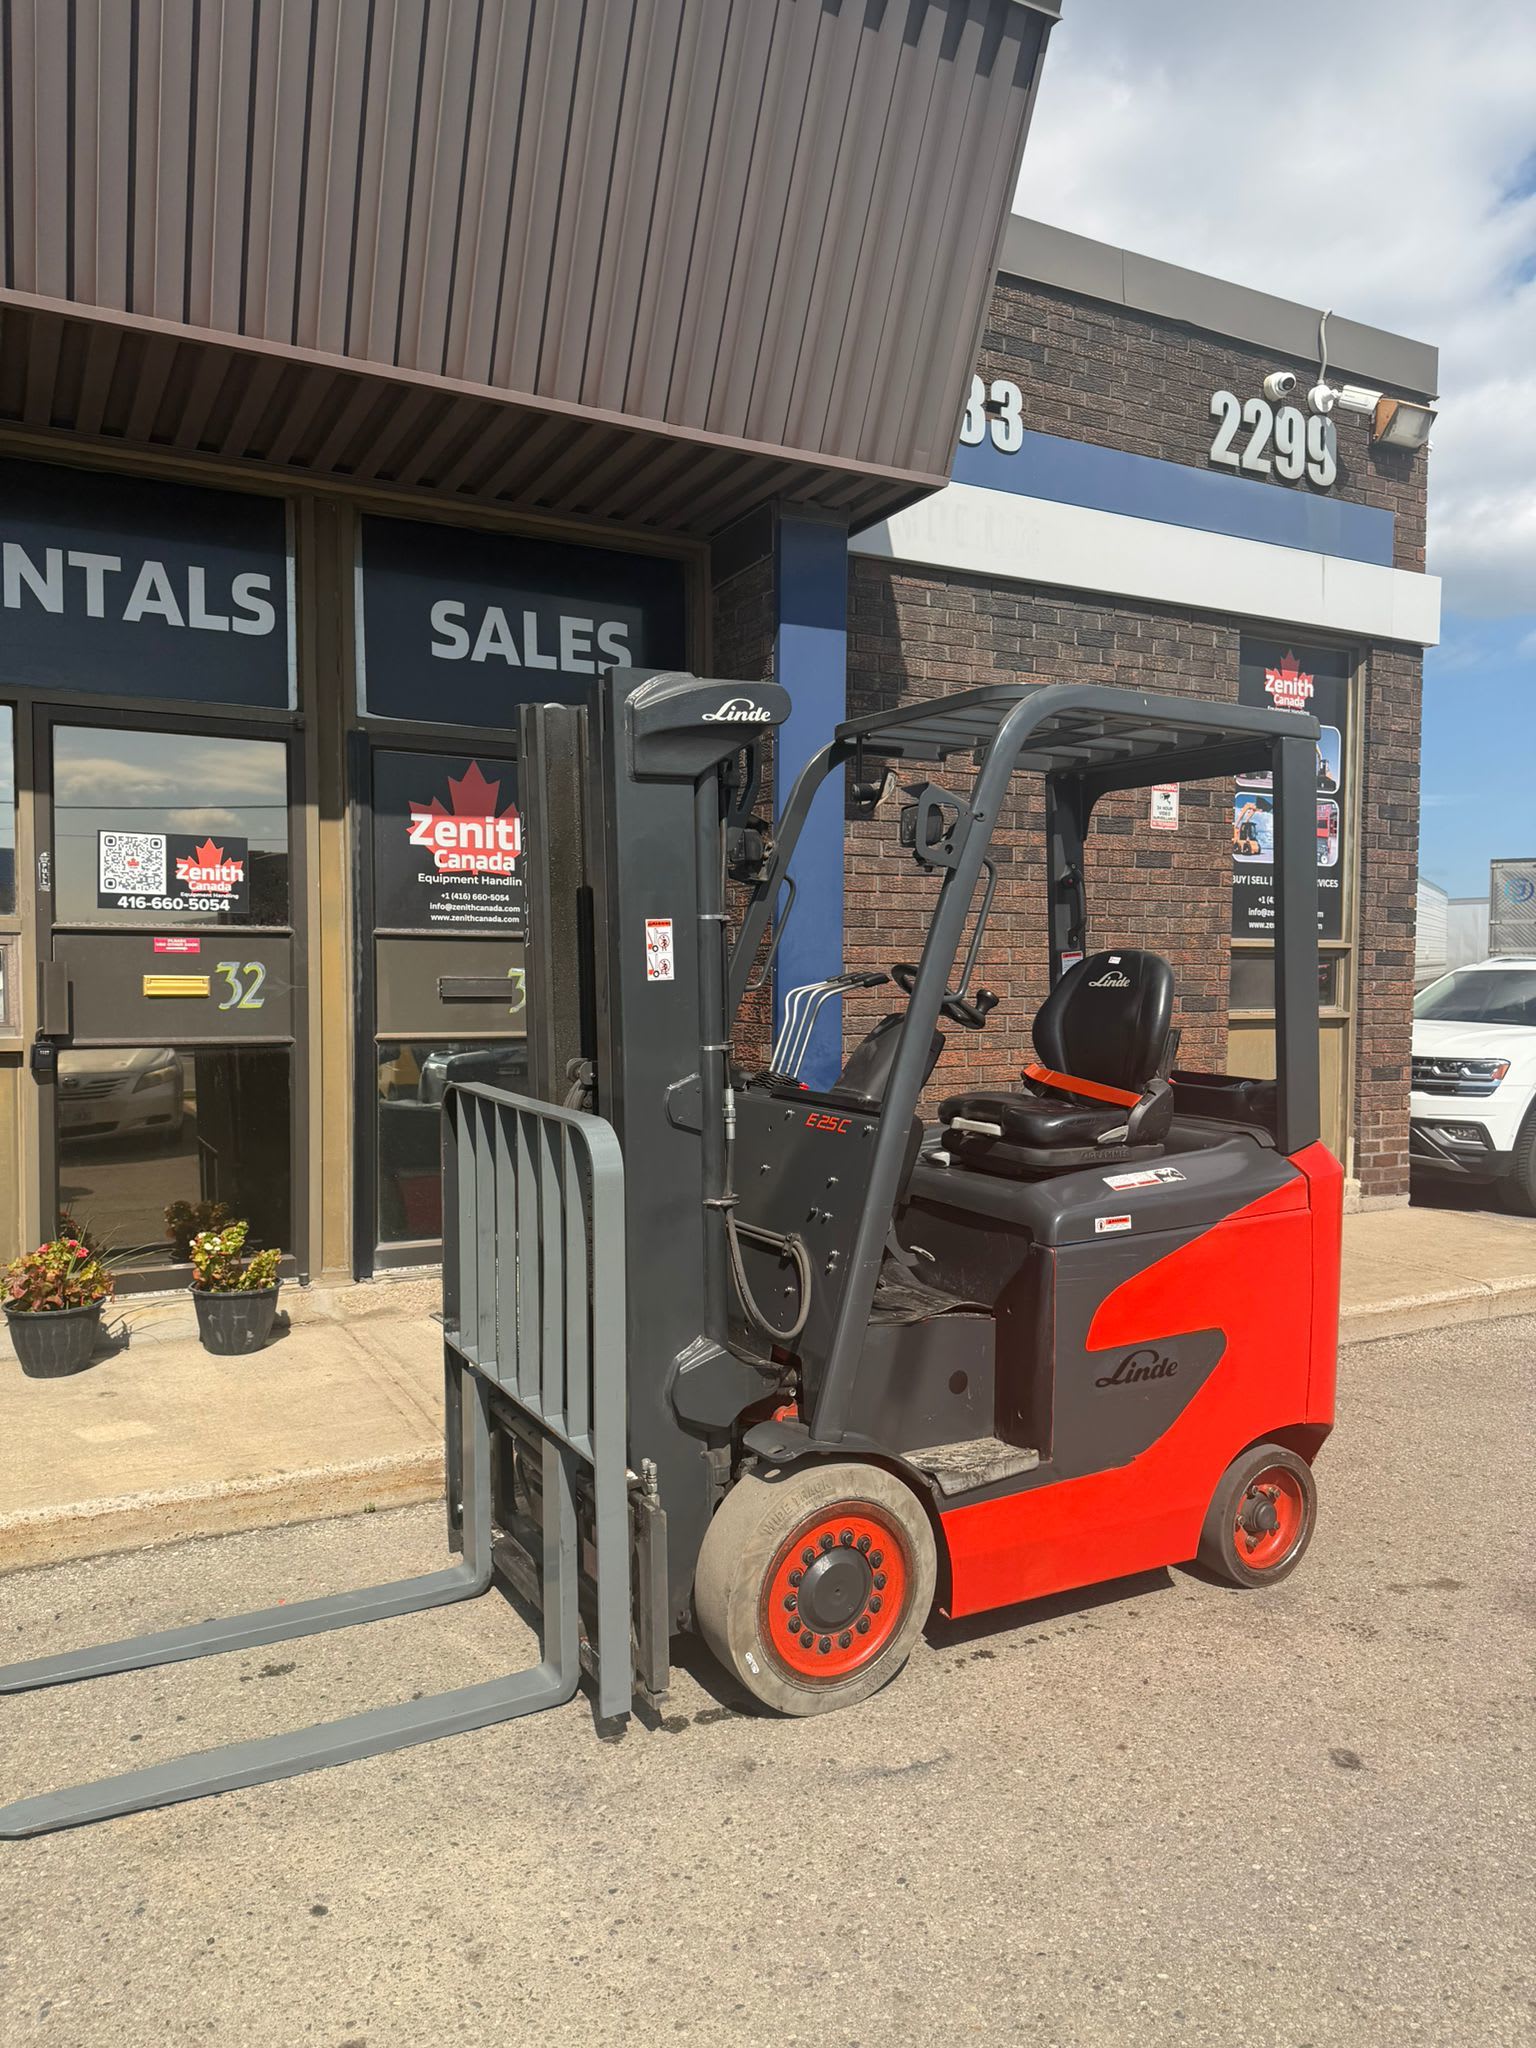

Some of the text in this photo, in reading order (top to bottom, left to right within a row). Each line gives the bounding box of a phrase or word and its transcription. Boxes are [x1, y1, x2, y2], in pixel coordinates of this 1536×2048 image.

[1210, 390, 1337, 486] 2299
[2, 542, 276, 636] NTALS
[430, 599, 632, 675] SALES
[1265, 674, 1314, 698] Zenith
[701, 698, 771, 722] Linde
[1274, 693, 1305, 708] Canada
[434, 849, 516, 871] Canada
[175, 863, 245, 882] Zenith
[417, 873, 523, 886] Equipment Handlin
[1251, 876, 1269, 885] SELL
[188, 881, 232, 892] Canada
[117, 896, 231, 911] 416-660-5054
[440, 892, 510, 902] +1 (416) 660-5054
[429, 902, 521, 912] info@zenithcanada.com
[430, 914, 520, 923] www.zenithcanada.com
[214, 961, 267, 1010] 32
[1088, 970, 1131, 987] Linde
[507, 967, 527, 1014] 3
[1095, 1349, 1178, 1388] Linde
